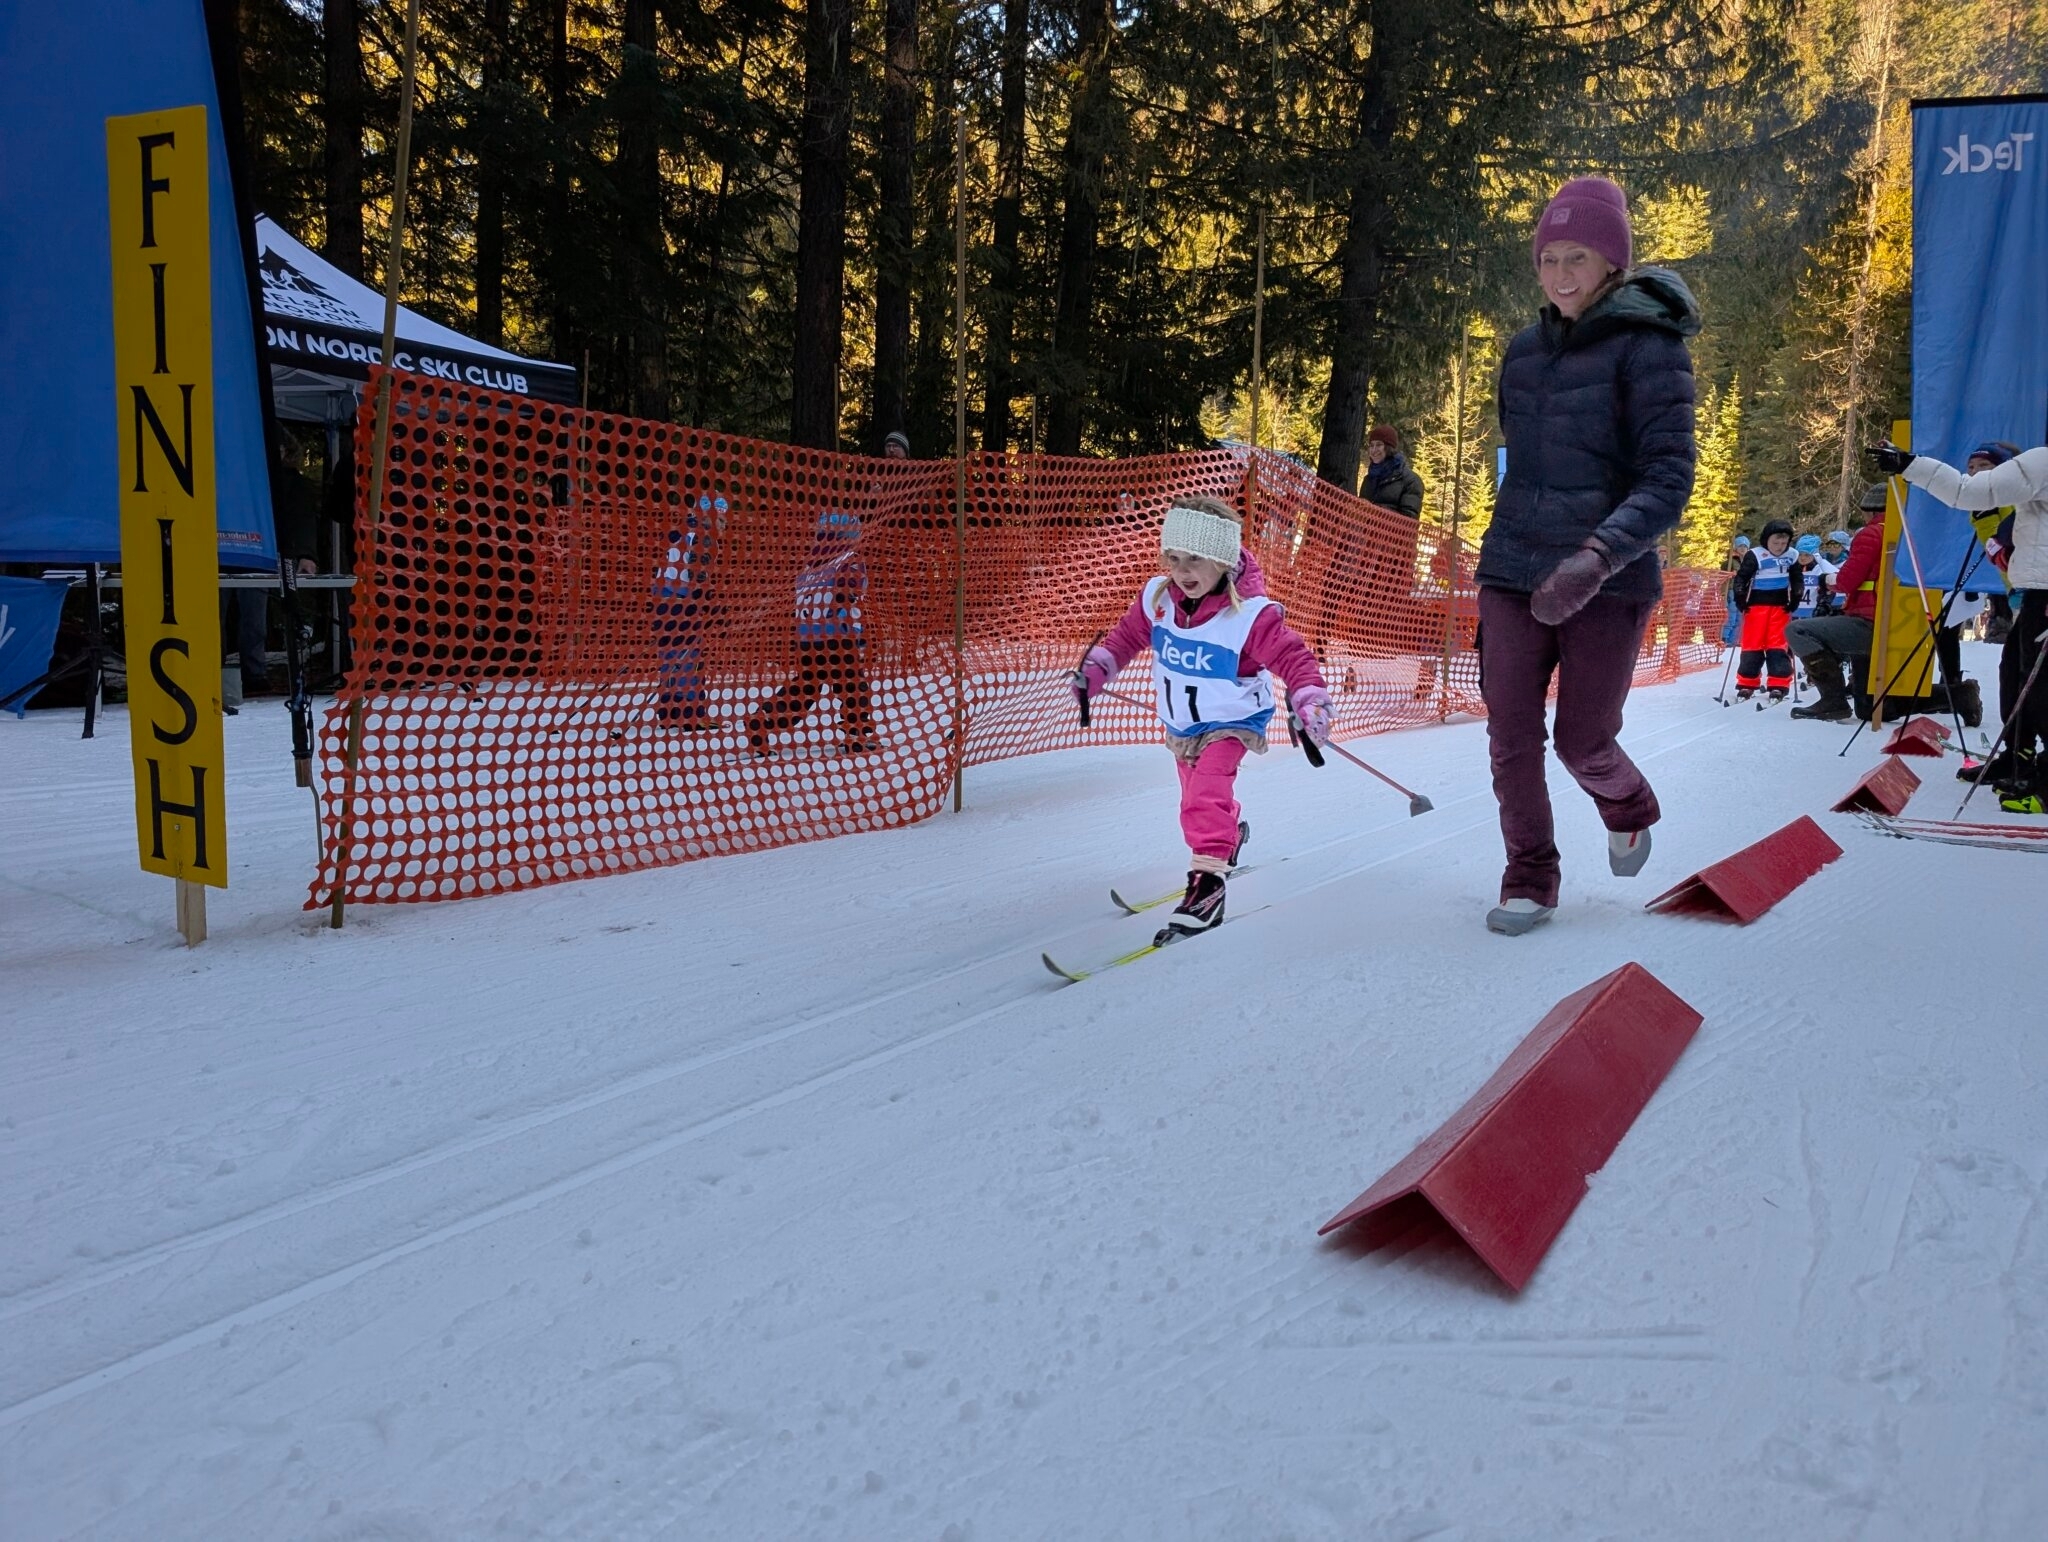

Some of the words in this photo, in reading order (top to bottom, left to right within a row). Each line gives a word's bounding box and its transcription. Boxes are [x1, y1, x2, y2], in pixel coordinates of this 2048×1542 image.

[306, 333, 415, 372] NORDC
[419, 356, 462, 382] SKI
[465, 365, 529, 394] CLUB
[130, 131, 210, 870] FINISH
[1162, 635, 1213, 671] Teck
[1163, 676, 1201, 723] 11
